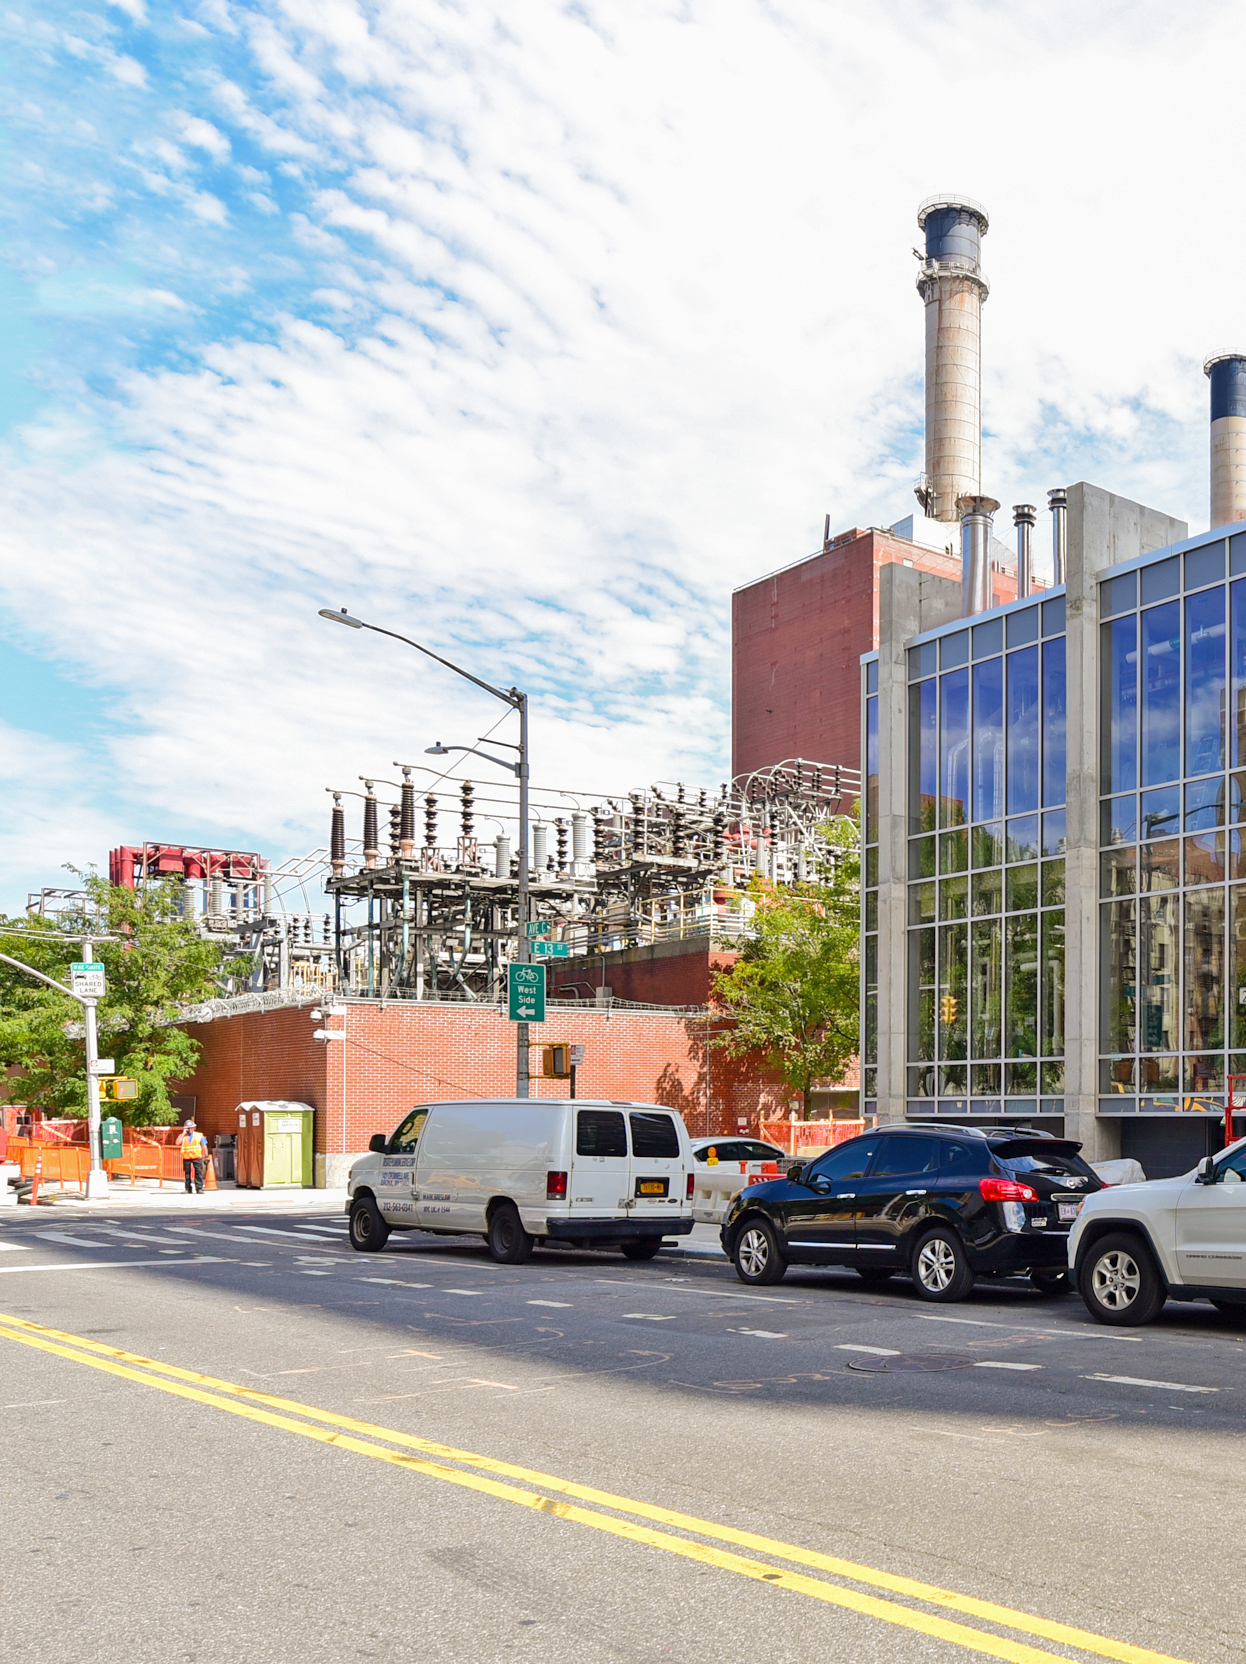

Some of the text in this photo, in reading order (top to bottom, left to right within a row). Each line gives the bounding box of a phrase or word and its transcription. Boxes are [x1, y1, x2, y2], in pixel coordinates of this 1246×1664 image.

[528, 922, 546, 935] AVE C
[534, 943, 540, 953] E
[544, 944, 554, 954] 13
[518, 985, 536, 994] West
[518, 995, 535, 1004] Side
